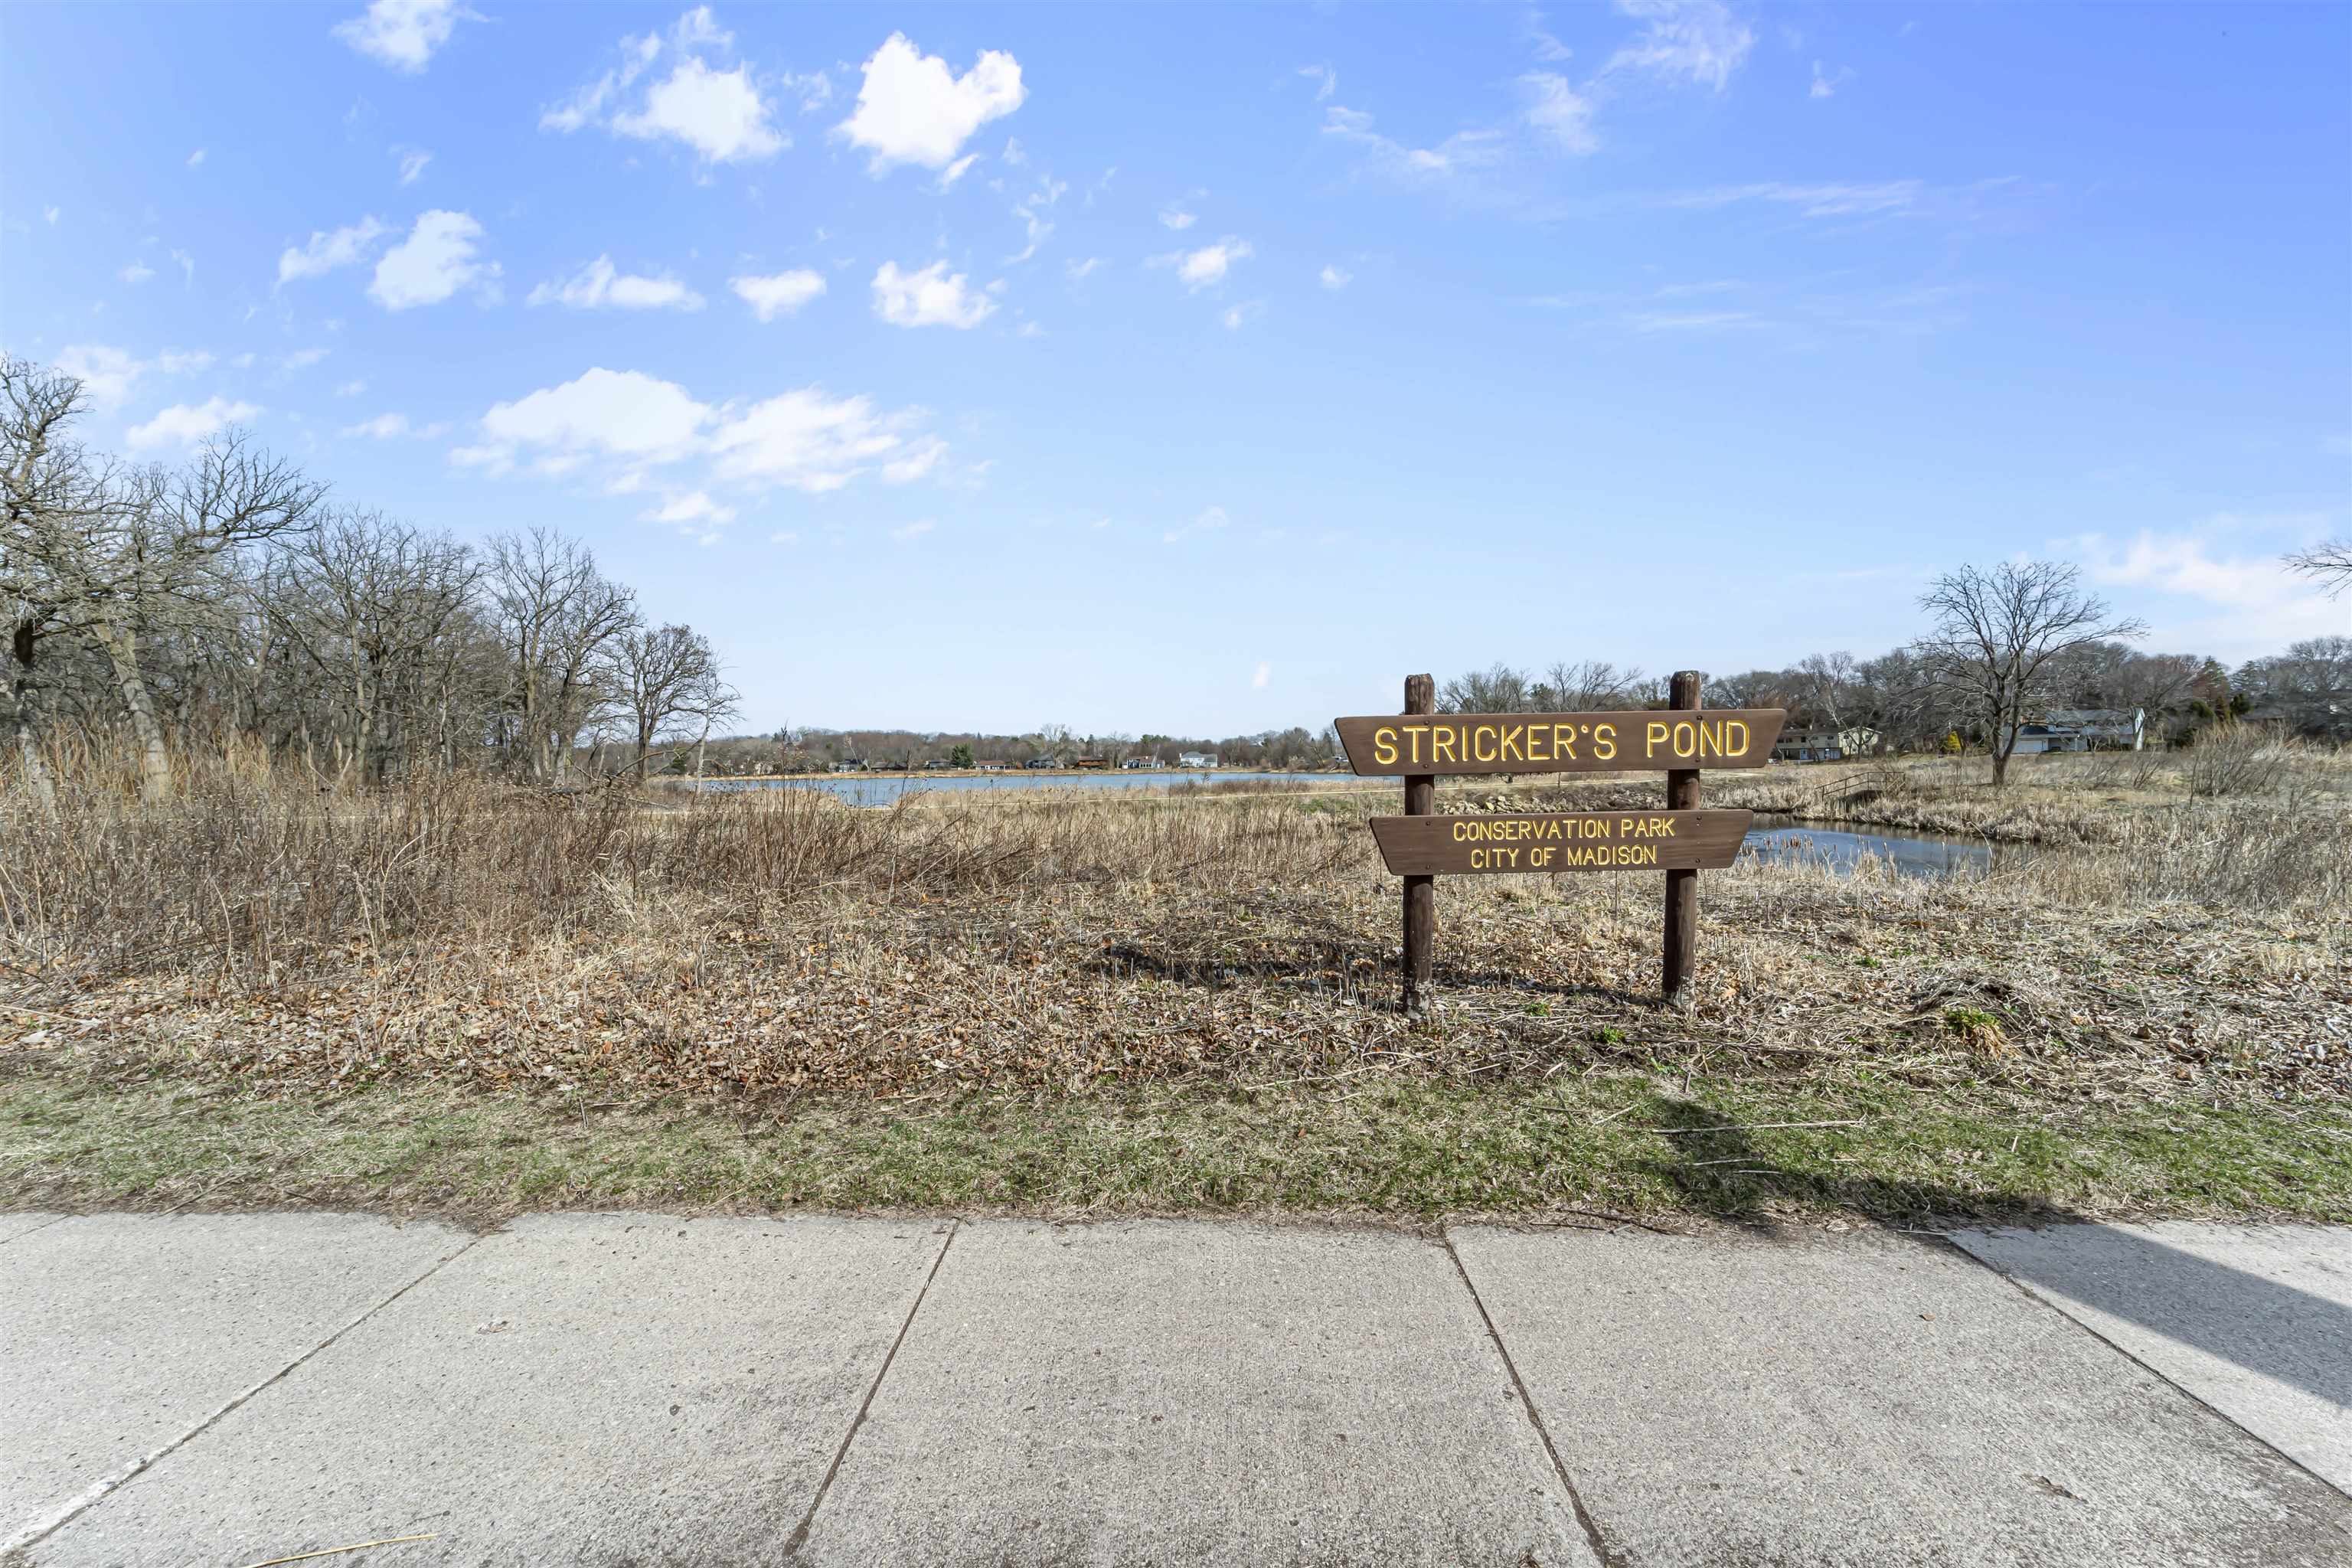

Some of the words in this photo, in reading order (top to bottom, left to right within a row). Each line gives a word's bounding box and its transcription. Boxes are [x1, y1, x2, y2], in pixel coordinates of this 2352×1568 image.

[1374, 722, 1618, 765] STRICKER'S
[1646, 719, 1751, 758] POND
[1453, 818, 1612, 842] CONSERVATION
[1620, 817, 1677, 838] PARK
[1471, 848, 1520, 869] CITY
[1530, 846, 1557, 867] OF
[1566, 844, 1658, 866] MADISON
